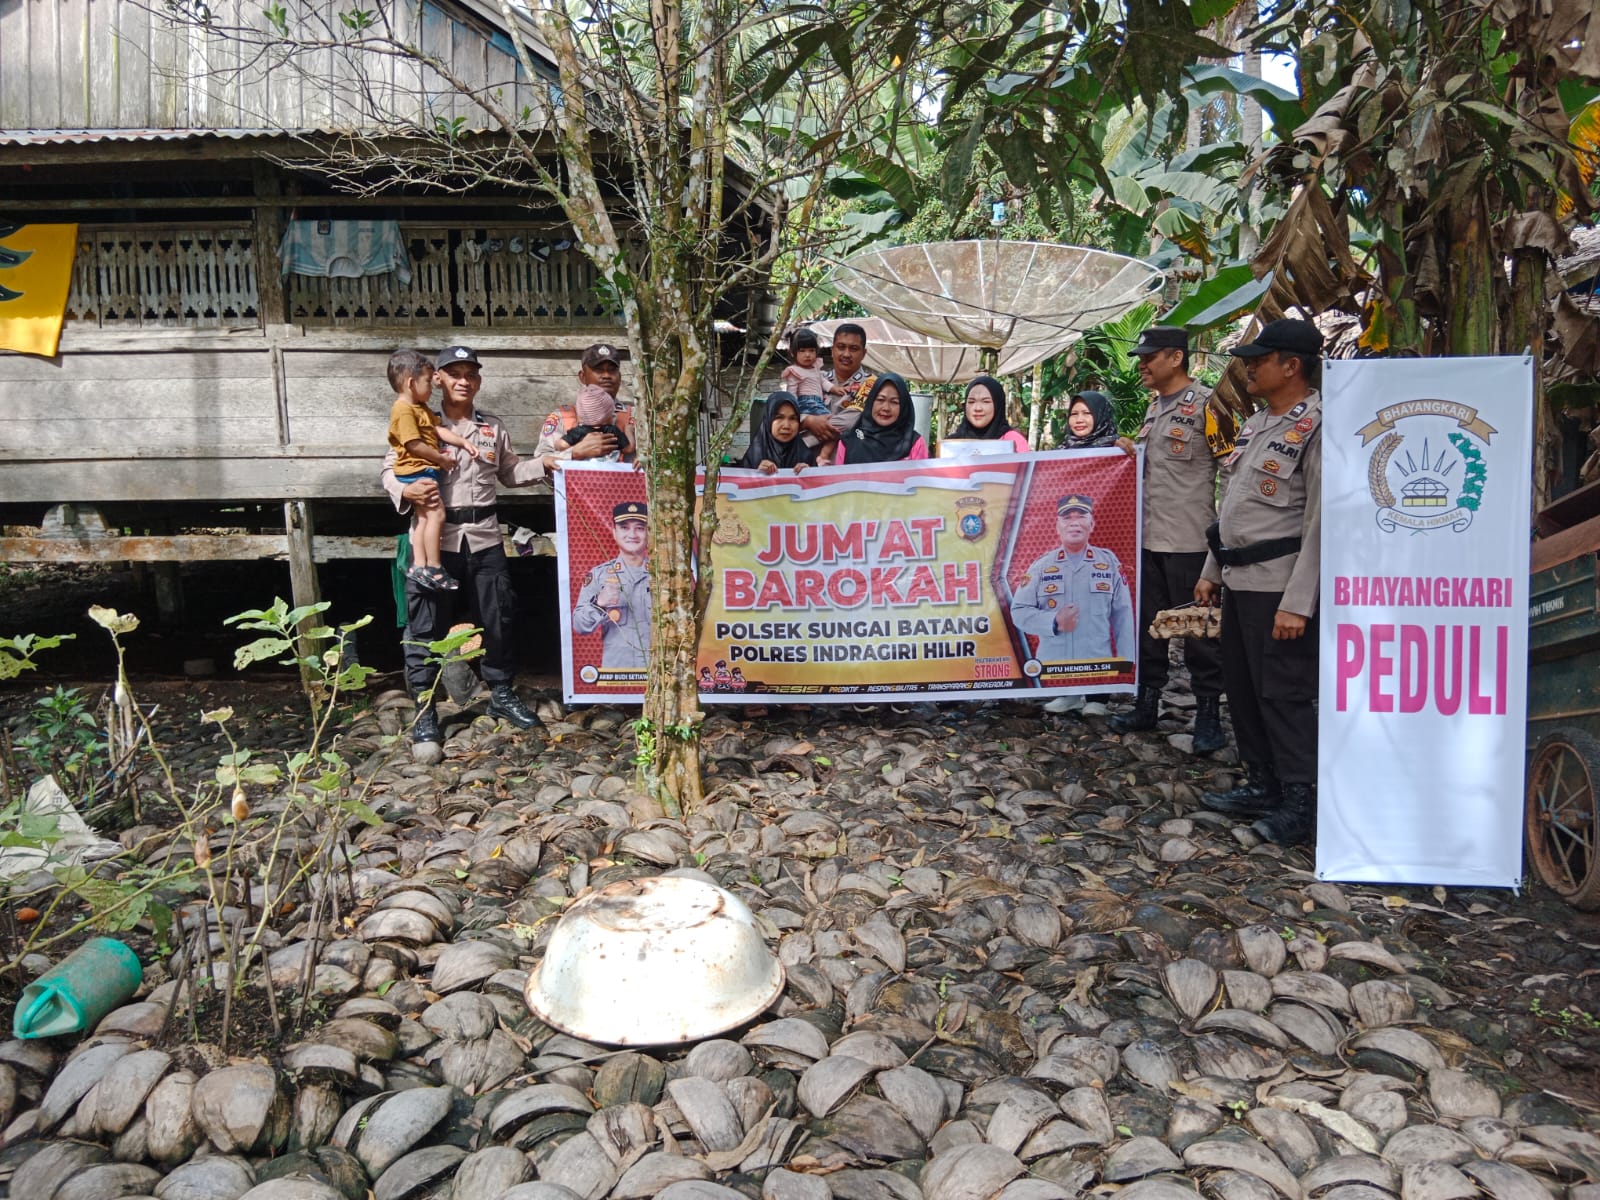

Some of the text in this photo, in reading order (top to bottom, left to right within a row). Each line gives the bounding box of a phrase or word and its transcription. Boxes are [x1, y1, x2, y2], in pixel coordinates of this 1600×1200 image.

[1170, 415, 1196, 426] POLRI
[1383, 401, 1471, 421] BHAYANGKARI
[1267, 441, 1300, 459] POLRI
[1387, 509, 1463, 527] KEMALA HIKMAH
[756, 517, 944, 564] JUM'AT
[724, 562, 980, 609] BAROKAH
[1334, 576, 1512, 607] BHAYANGKARI
[716, 616, 989, 640] POLSEK SUNGAI BATANG
[730, 641, 976, 662] POLRES INDRAGIRI HILIR
[974, 663, 1010, 678] STRONG
[1336, 623, 1508, 716] PEDULI
